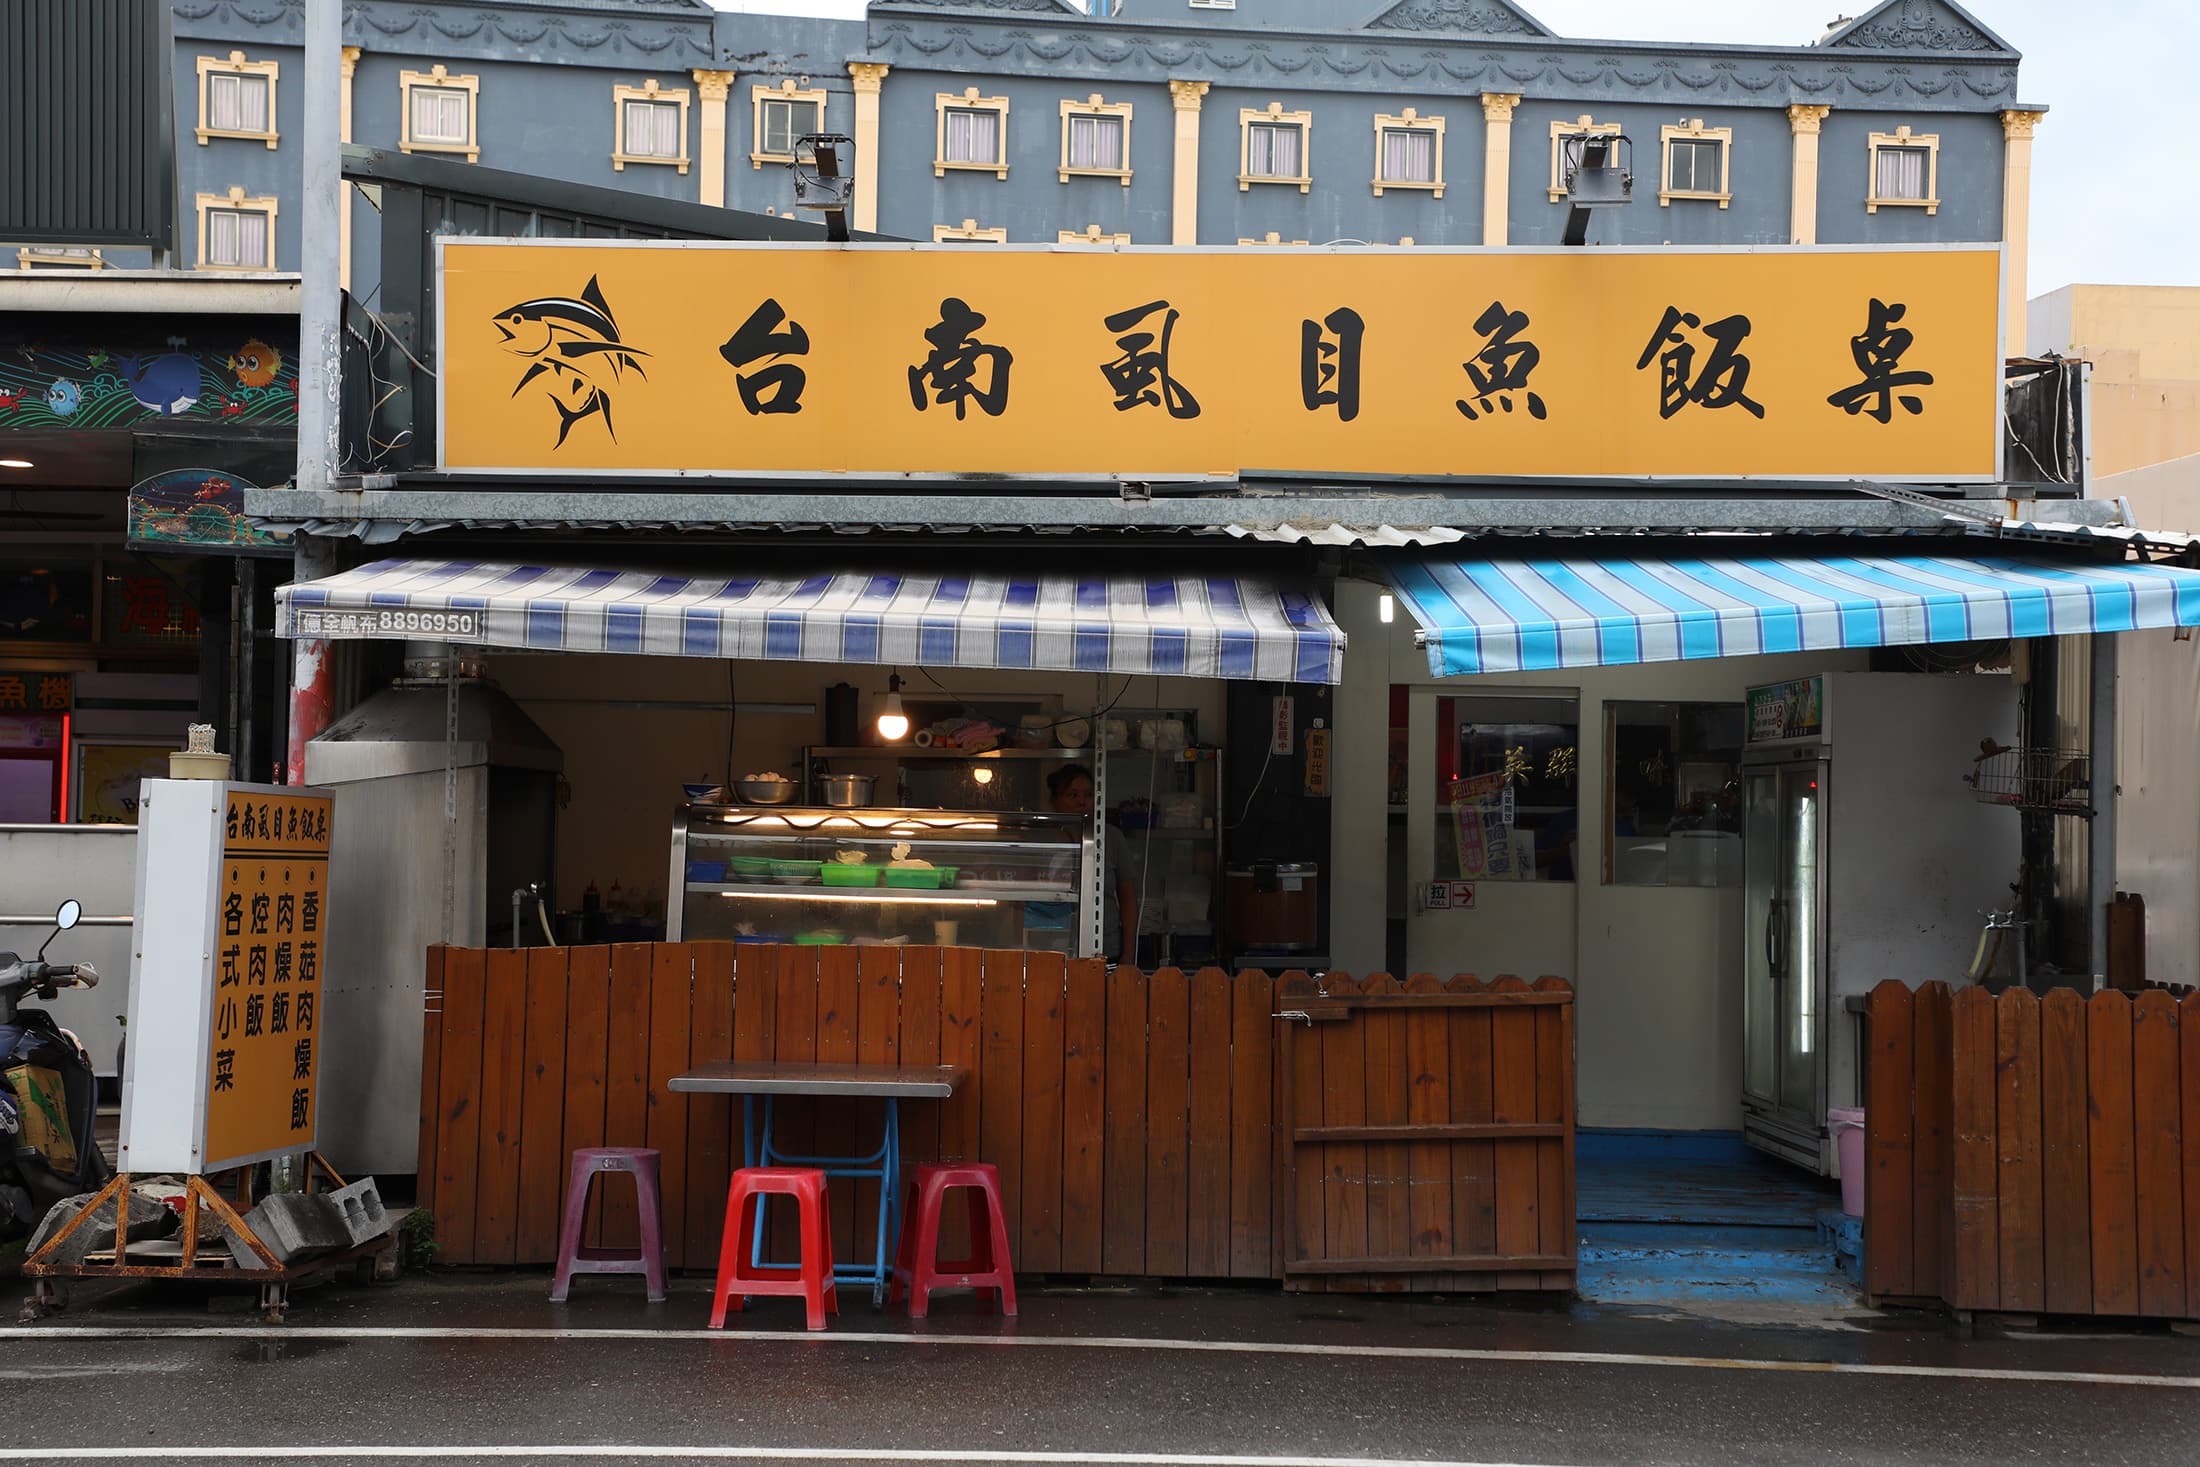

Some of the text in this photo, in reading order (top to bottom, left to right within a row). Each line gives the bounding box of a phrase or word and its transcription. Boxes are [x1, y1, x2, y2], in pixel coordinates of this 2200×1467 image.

[718, 297, 1935, 425] 台南虱目魚飯桌
[379, 611, 472, 633] 8896950
[1431, 884, 1446, 899] 拉
[214, 891, 243, 1092] 各式小菜
[245, 891, 270, 1038] 焢肉飯
[270, 892, 295, 1035] 肉燥飯
[290, 890, 319, 1131] 香菇肉燥飯
